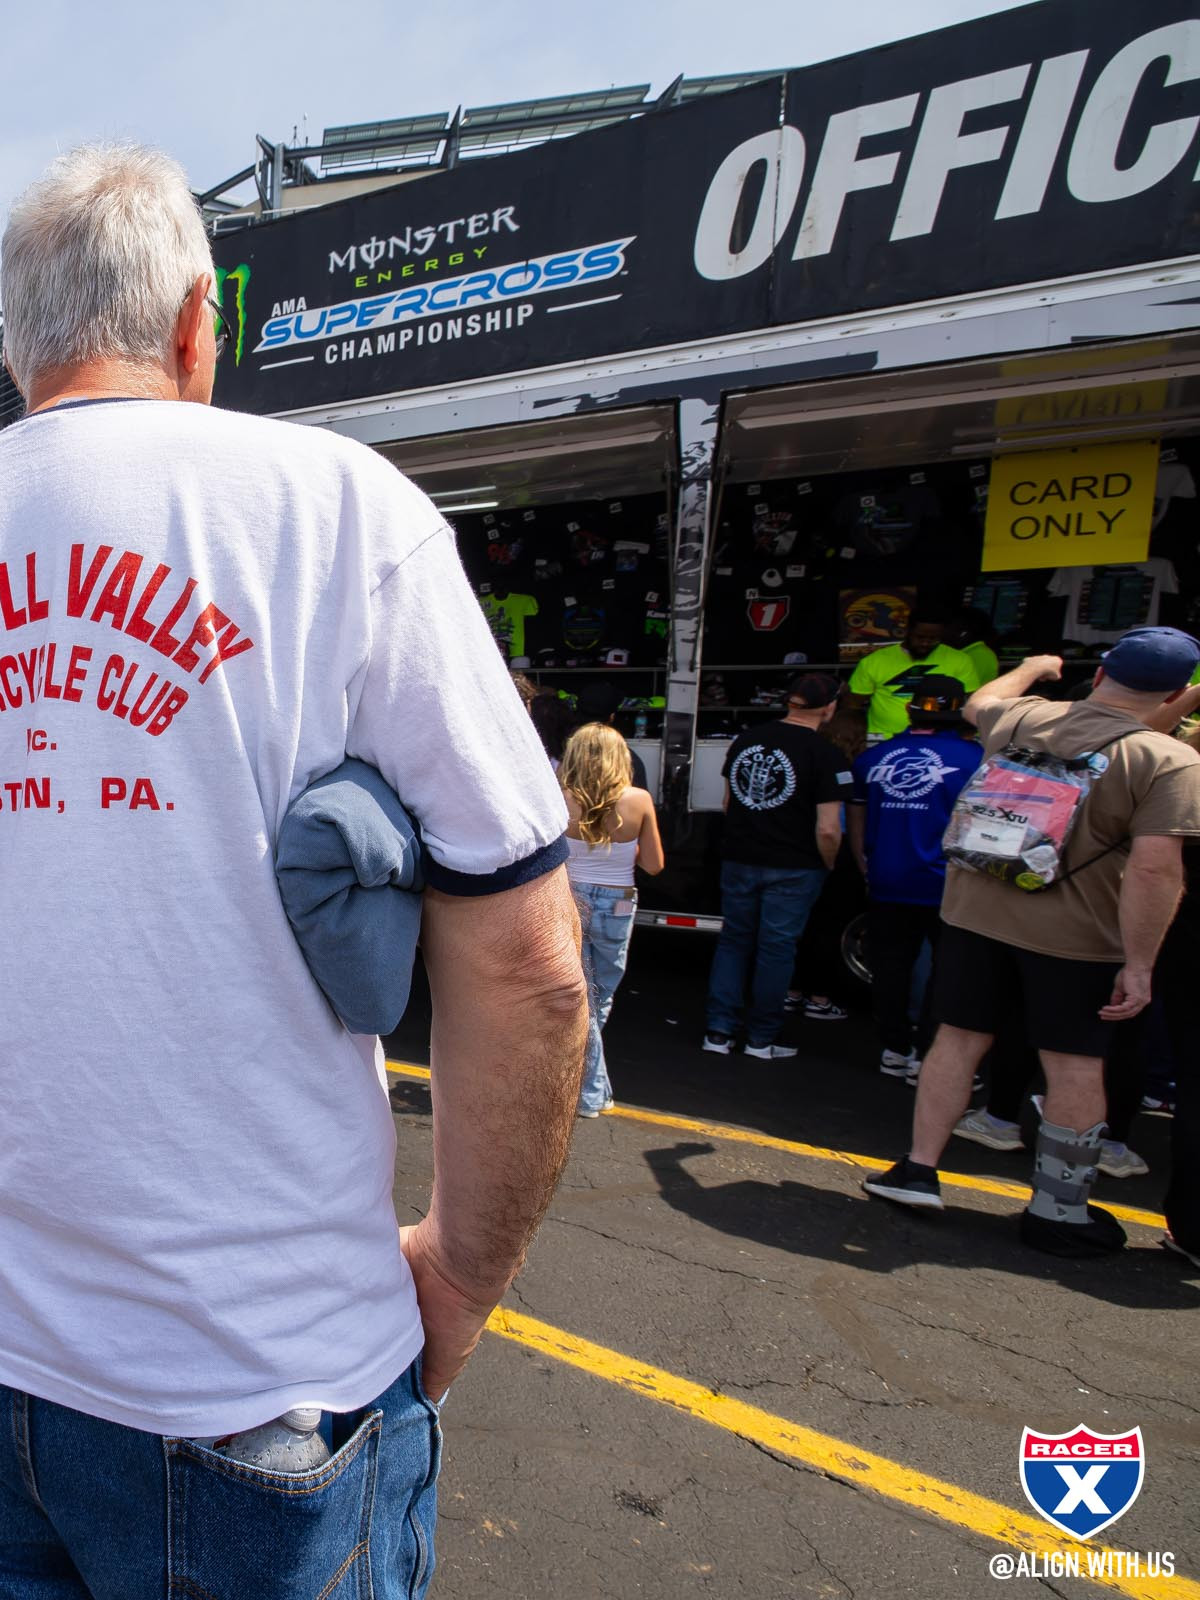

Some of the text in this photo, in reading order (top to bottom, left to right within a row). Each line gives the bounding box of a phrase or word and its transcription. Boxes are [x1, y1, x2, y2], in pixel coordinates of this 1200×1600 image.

[693, 18, 1200, 281] OFFIC
[327, 205, 521, 273] MONSTER
[354, 245, 488, 289] ENERGY
[258, 239, 631, 350] SUPERCROSS
[271, 296, 308, 319] AMA
[324, 303, 535, 365] CHAMPIONSHIP
[1008, 472, 1133, 506] CARD
[1009, 508, 1127, 541] ONLY
[66, 543, 255, 686] VALLEY
[96, 653, 190, 737] CLUB
[100, 777, 175, 811] PA.
